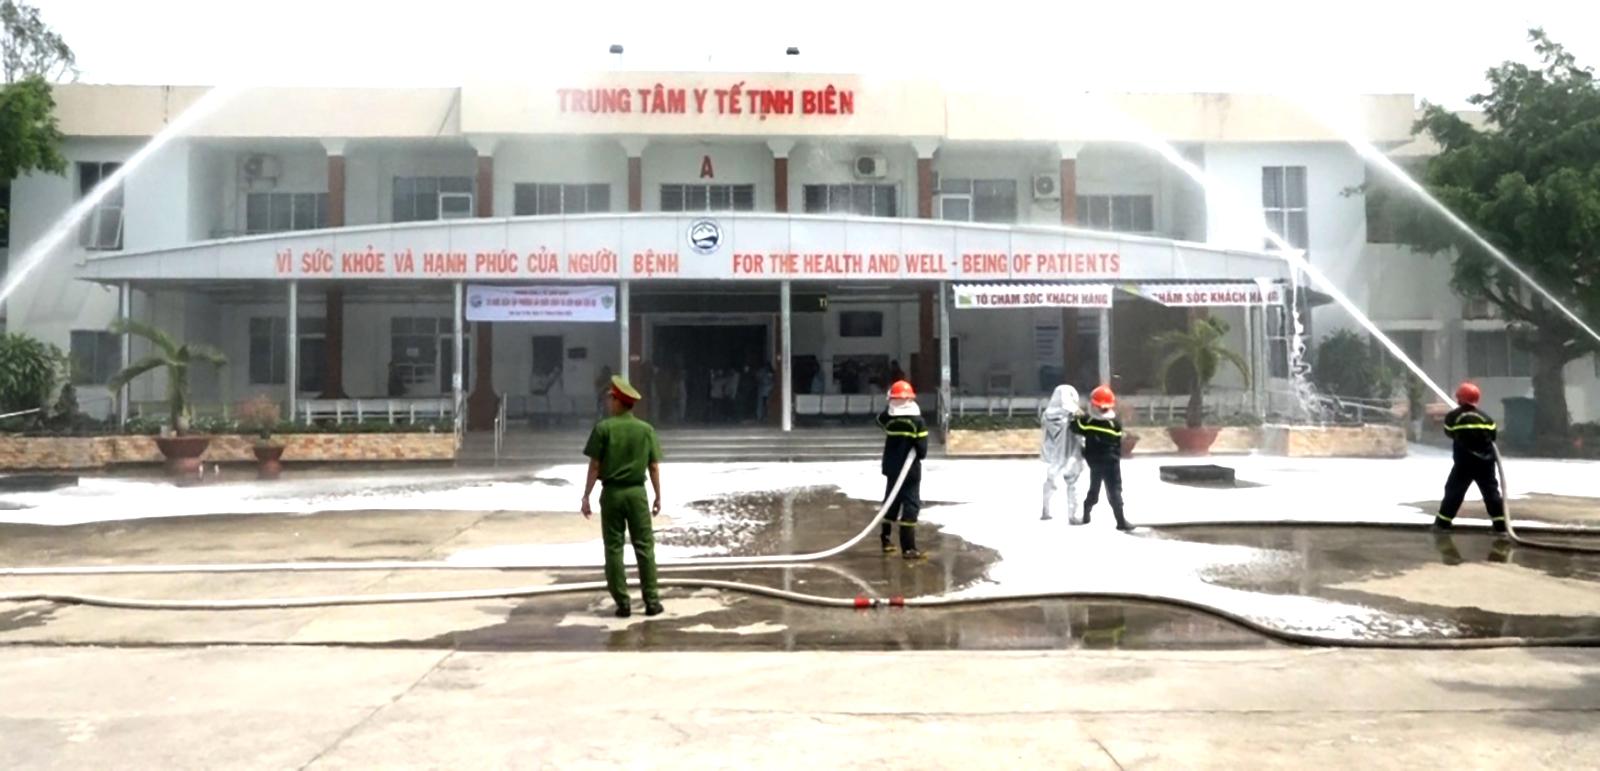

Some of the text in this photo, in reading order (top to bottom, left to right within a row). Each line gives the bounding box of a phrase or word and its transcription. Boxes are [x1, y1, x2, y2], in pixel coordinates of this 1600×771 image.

[556, 81, 854, 121] TRUNG TÂM Y TẾ TỊNH BIÊN
[700, 155, 715, 179] A
[276, 244, 680, 277] VÌ SỨC KHỎE VÀ HẠNH PHÚC CỦA NGƯỜI BỆNH
[733, 253, 764, 273] FOR
[769, 254, 799, 273] THE
[803, 254, 863, 274] HEALTH
[867, 253, 900, 273] AND
[905, 254, 948, 274] WELL
[962, 253, 1008, 274] BEING
[1013, 253, 1033, 273] OF
[1037, 253, 1121, 273] PATIENTS
[1210, 290, 1247, 304] KHÁCH
